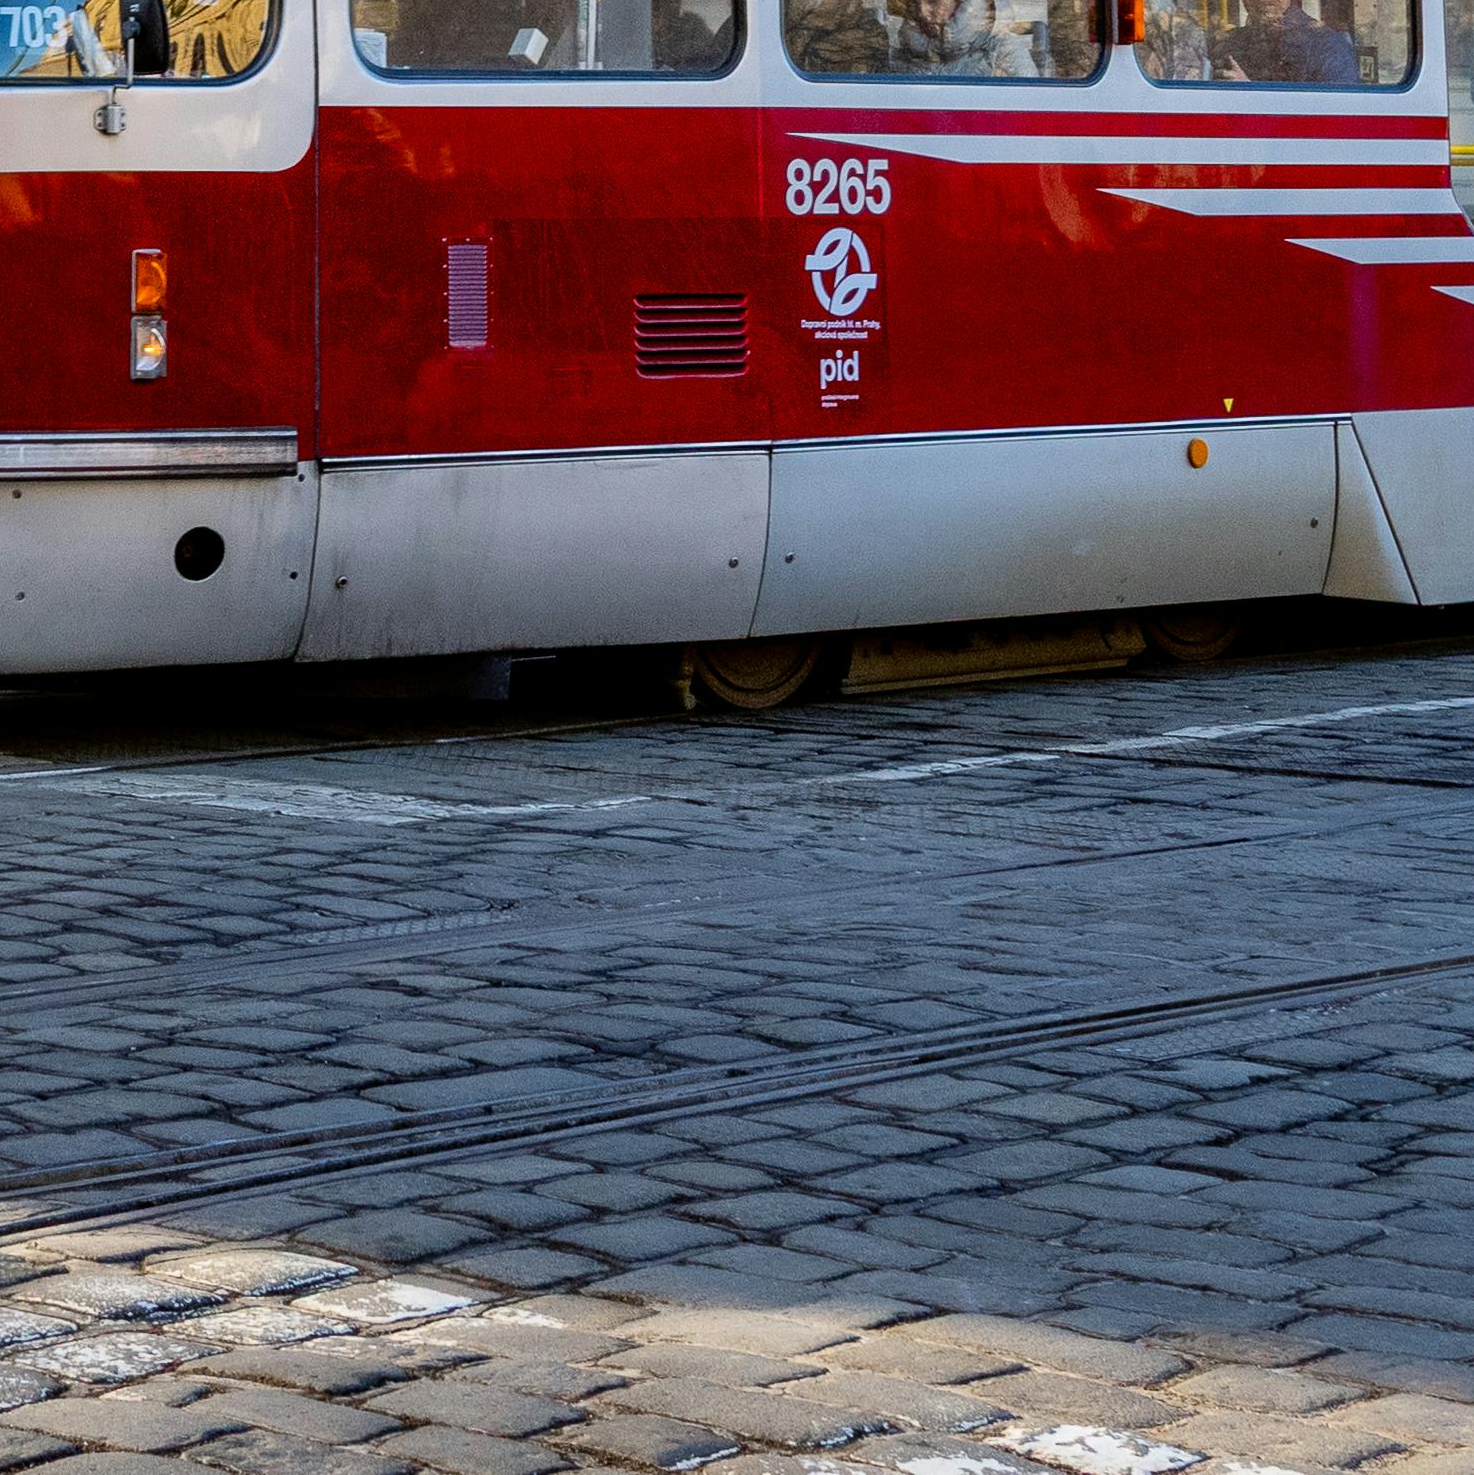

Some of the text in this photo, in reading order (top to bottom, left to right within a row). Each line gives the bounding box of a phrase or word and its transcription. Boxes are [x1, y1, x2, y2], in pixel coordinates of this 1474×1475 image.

[0, 5, 69, 48] 703
[785, 158, 891, 215] 8265
[820, 349, 860, 390] pid
